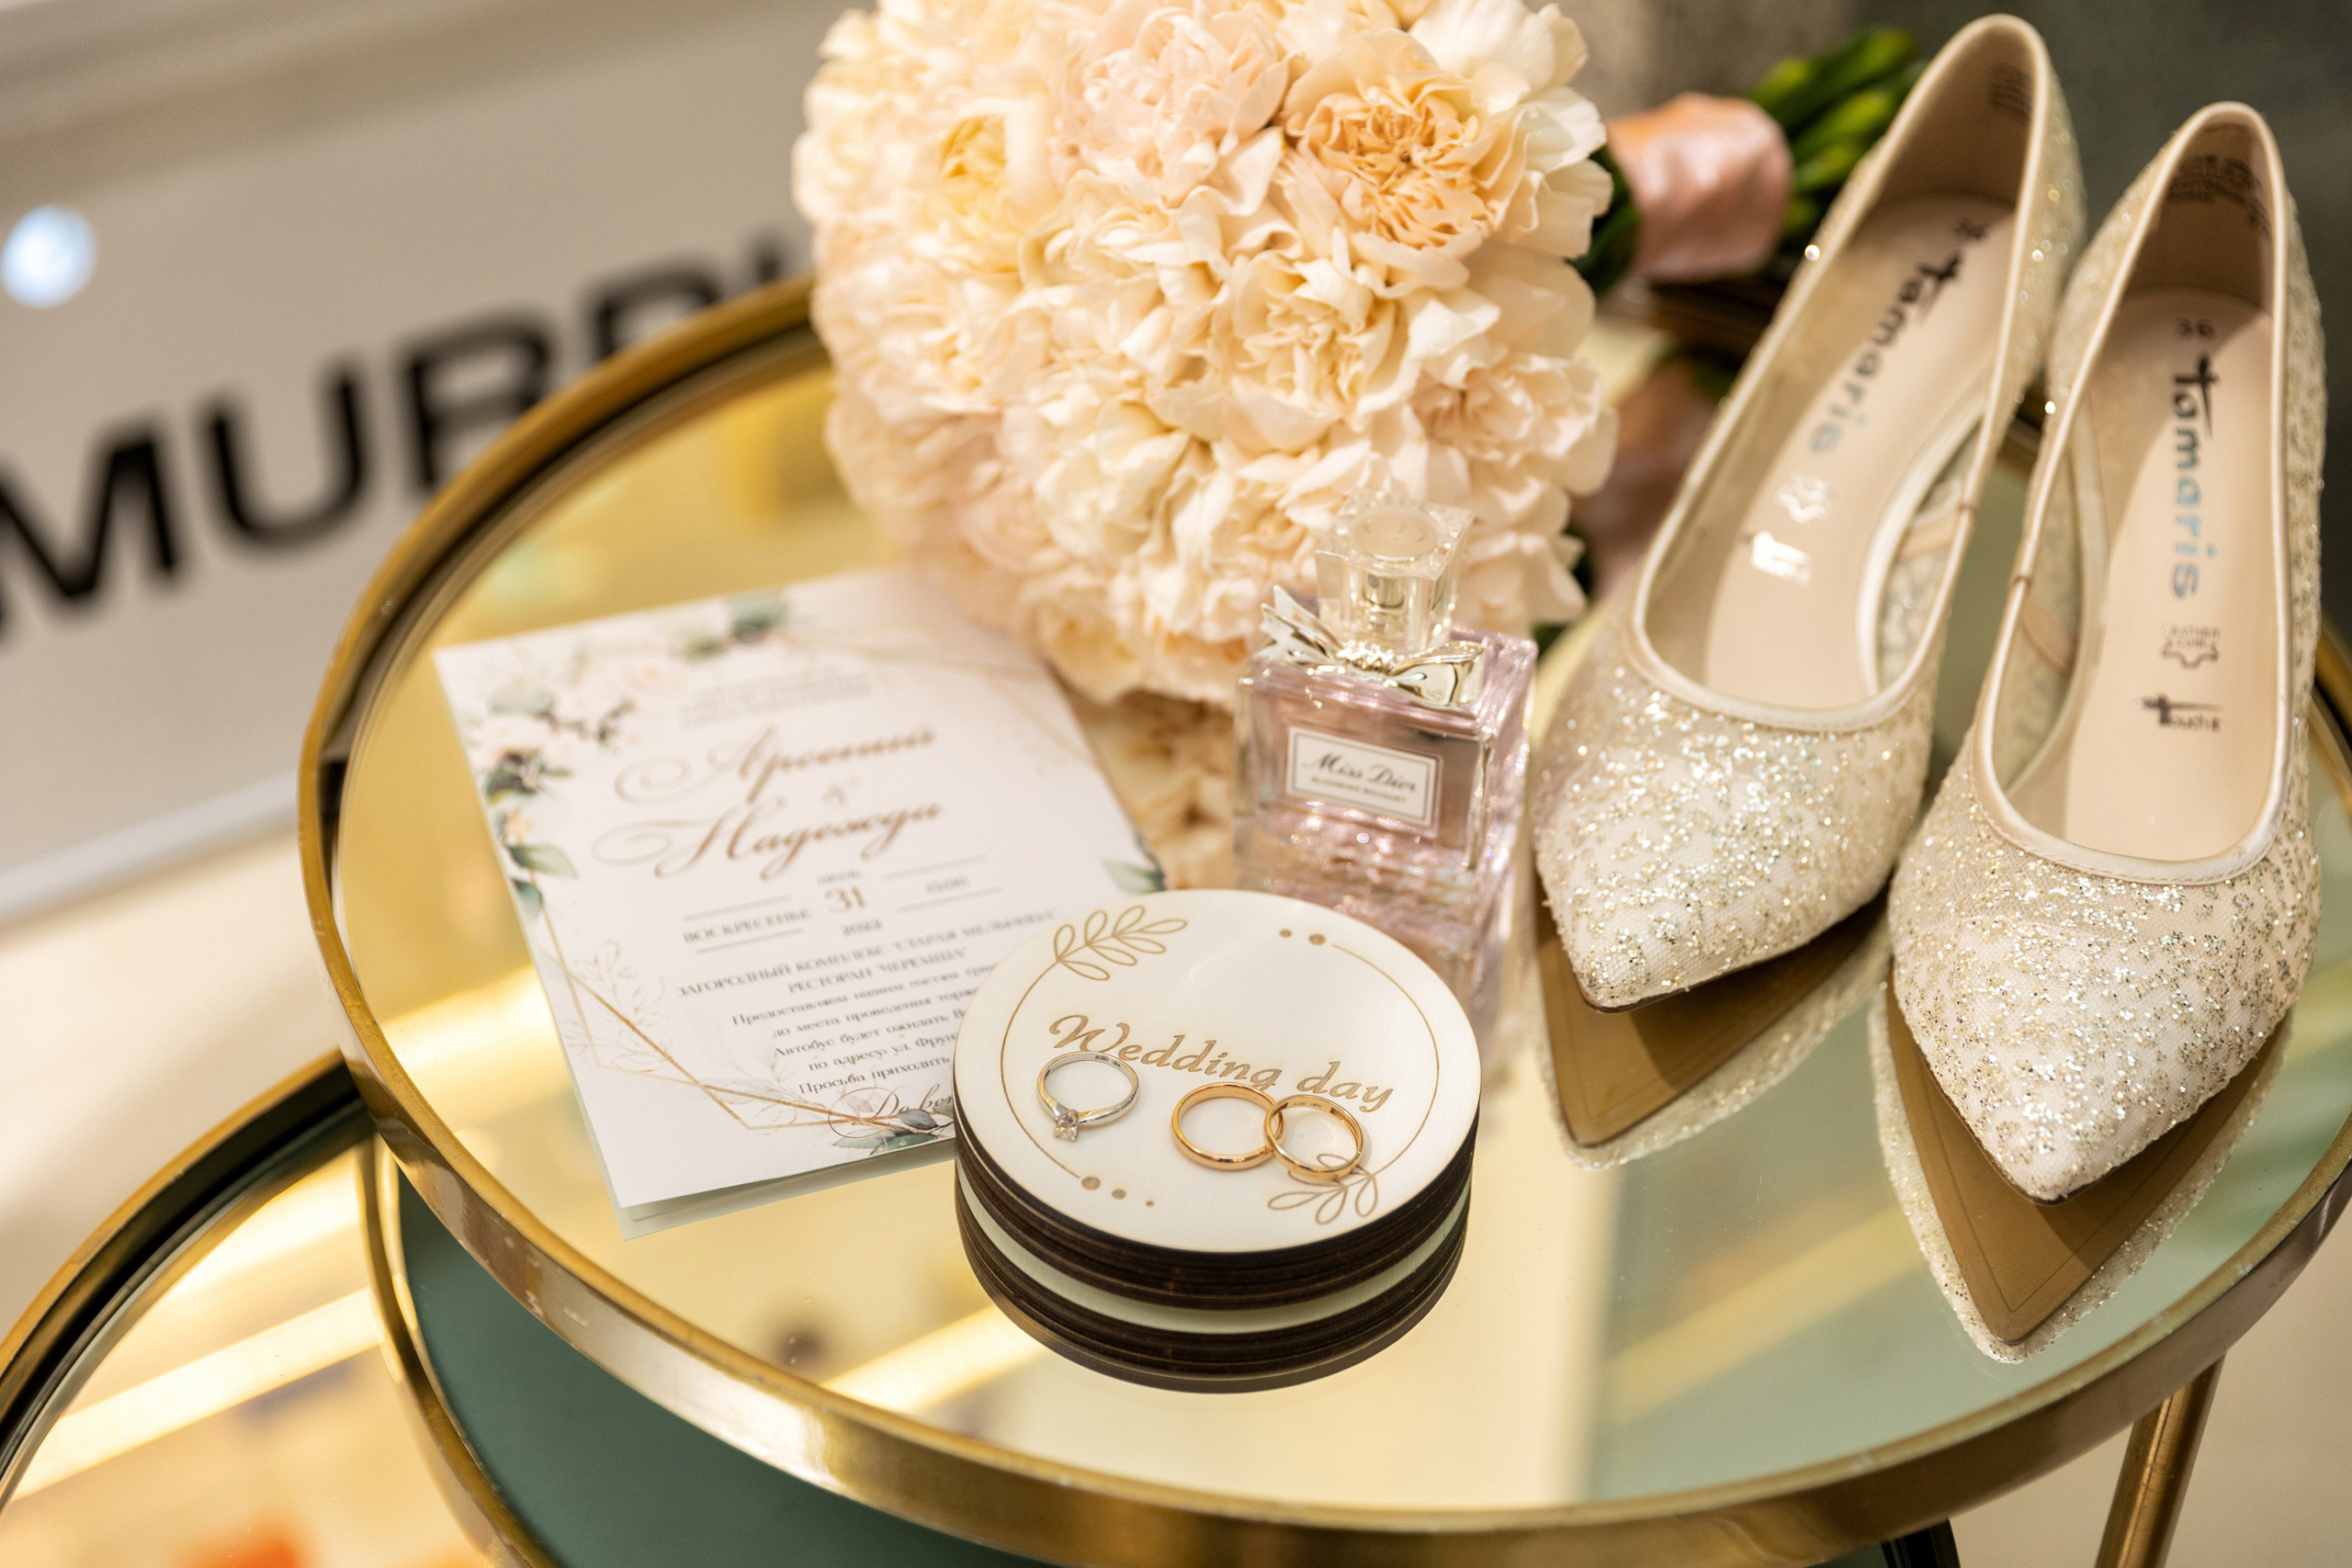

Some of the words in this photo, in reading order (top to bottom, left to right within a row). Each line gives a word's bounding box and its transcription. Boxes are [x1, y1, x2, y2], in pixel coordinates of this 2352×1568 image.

[1301, 751, 1363, 779] Miss
[1365, 763, 1418, 792] Dior
[823, 886, 866, 913] 31
[684, 908, 811, 943] ВОСКРЕСЕНЬЕ
[676, 955, 792, 998] ЗАГОРОДНЫЙ
[795, 944, 887, 974] КОМПЛЕКС
[787, 967, 874, 995] РЕСТОРАН
[796, 1015, 842, 1033] места
[845, 998, 933, 1023] проведения
[773, 1038, 836, 1058] Автобус
[840, 1028, 881, 1046] будет
[886, 1014, 950, 1034] ожидать
[798, 1073, 866, 1095] Просьба
[871, 1055, 952, 1080] приходить
[808, 1059, 828, 1072] по
[1048, 1013, 1283, 1090] Wedding
[1295, 1061, 1395, 1114] day
